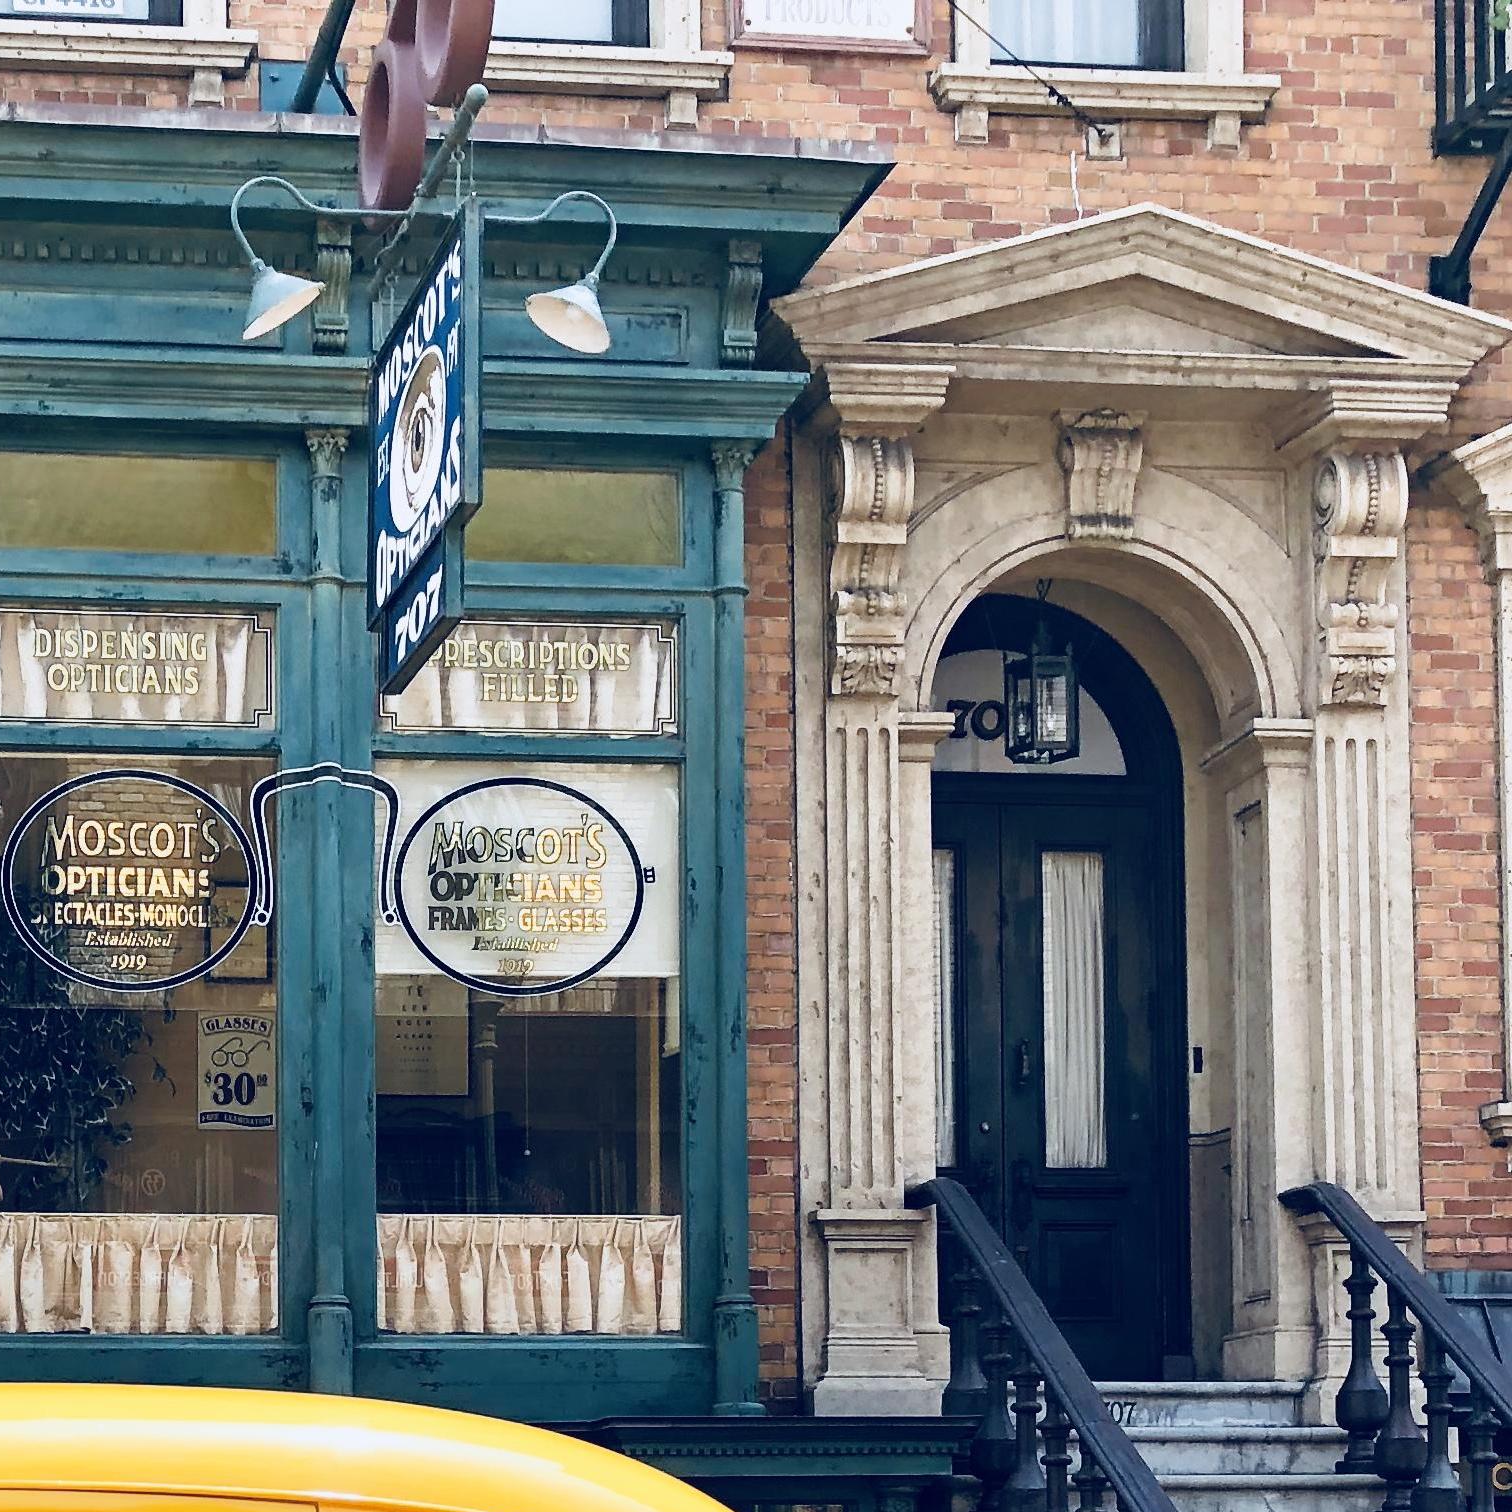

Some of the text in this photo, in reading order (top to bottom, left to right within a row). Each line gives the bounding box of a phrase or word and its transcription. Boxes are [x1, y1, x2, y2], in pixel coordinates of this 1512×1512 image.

[375, 415, 461, 608] OPTICIANS
[395, 562, 444, 665] 707
[34, 628, 207, 661] DISPENSING
[427, 639, 631, 671] PRESCRIPTIONS
[47, 663, 199, 694] OPTICIANS
[482, 673, 578, 702] FILLED
[41, 808, 220, 867] MOSCOT'S
[428, 813, 607, 876] MOSCOT'S
[41, 865, 216, 898] OPTICIANS
[430, 871, 602, 903] OPTICIANS
[428, 905, 608, 932] FRAMES GLASSES
[85, 931, 172, 947] Established
[472, 936, 559, 953] Established
[110, 953, 147, 970] 1919
[497, 958, 534, 975] 1919
